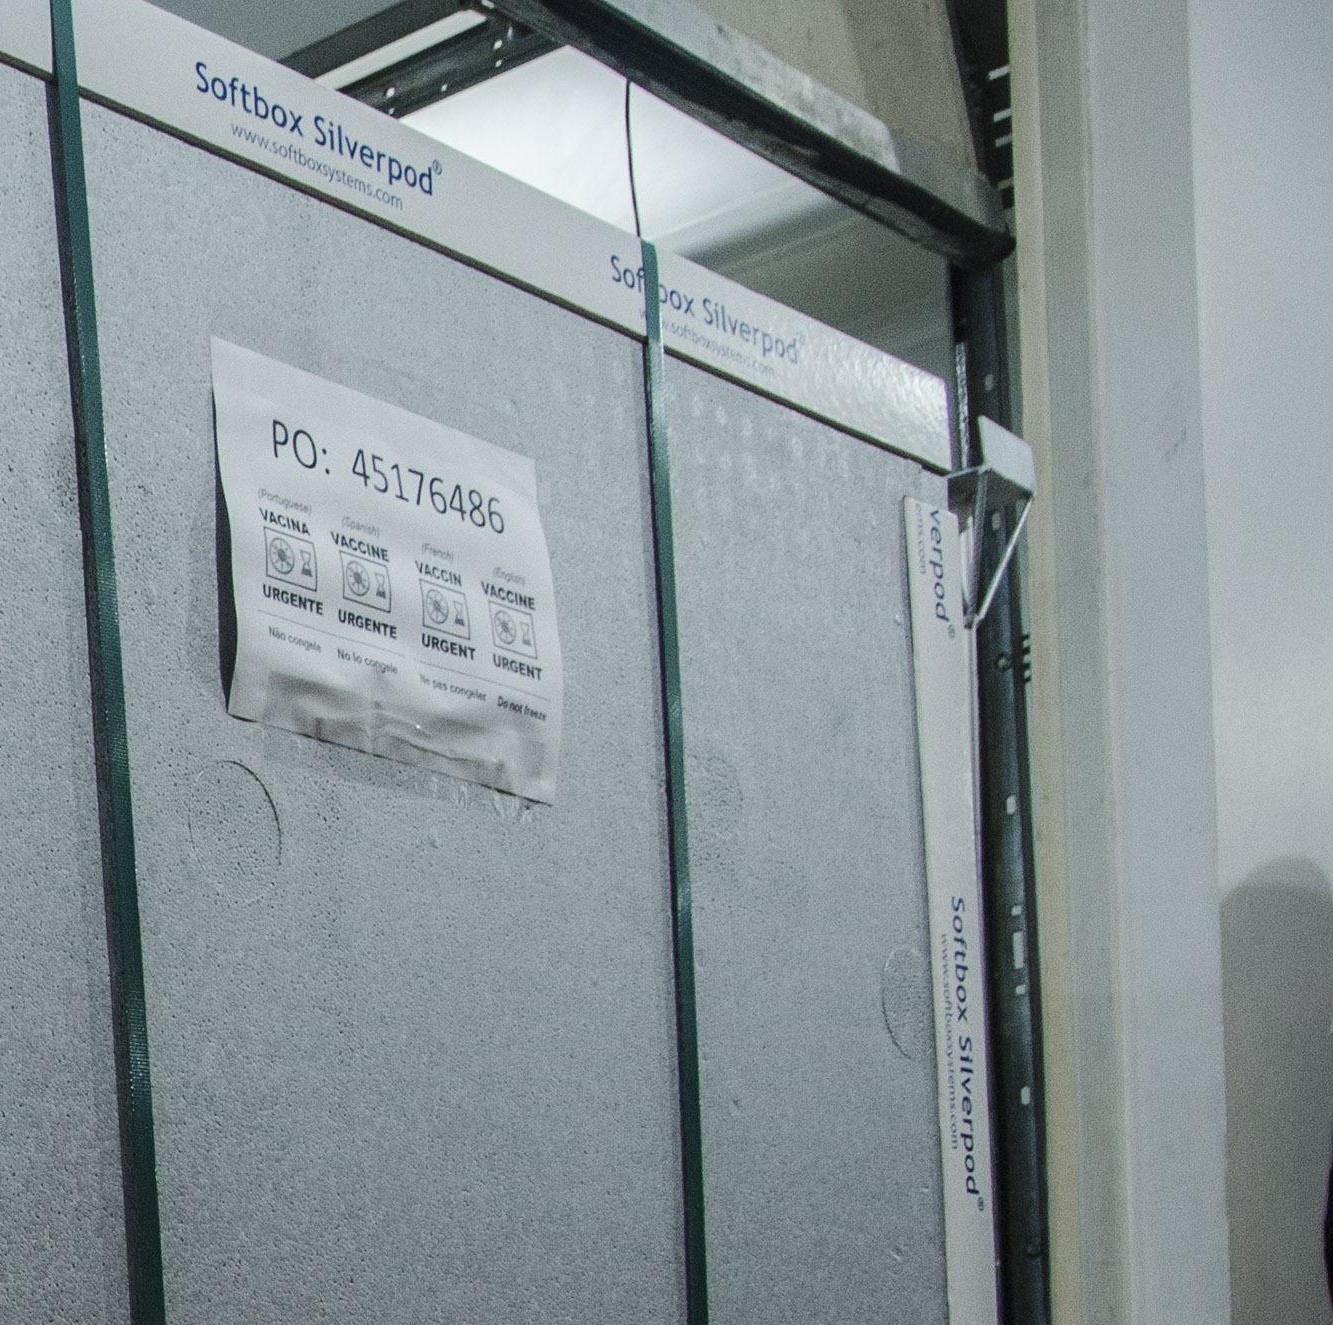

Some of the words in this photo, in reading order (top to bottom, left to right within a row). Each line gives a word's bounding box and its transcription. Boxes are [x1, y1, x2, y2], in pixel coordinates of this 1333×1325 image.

[195, 62, 304, 137] Softbox
[231, 124, 404, 211] www.softboxsystems.com
[272, 419, 330, 475] PO:
[352, 448, 505, 534] 45176486
[258, 487, 312, 516] (Portuguese)
[258, 507, 311, 537] VACINA
[330, 531, 390, 562] VACCINE
[414, 559, 462, 587] VACCIN
[262, 583, 324, 616] URGENTE
[481, 580, 536, 611] VACCINE
[338, 608, 398, 640] URGENTE
[421, 632, 476, 661] URGENT
[493, 653, 543, 681] URGENT
[950, 896, 969, 1022] Softbox
